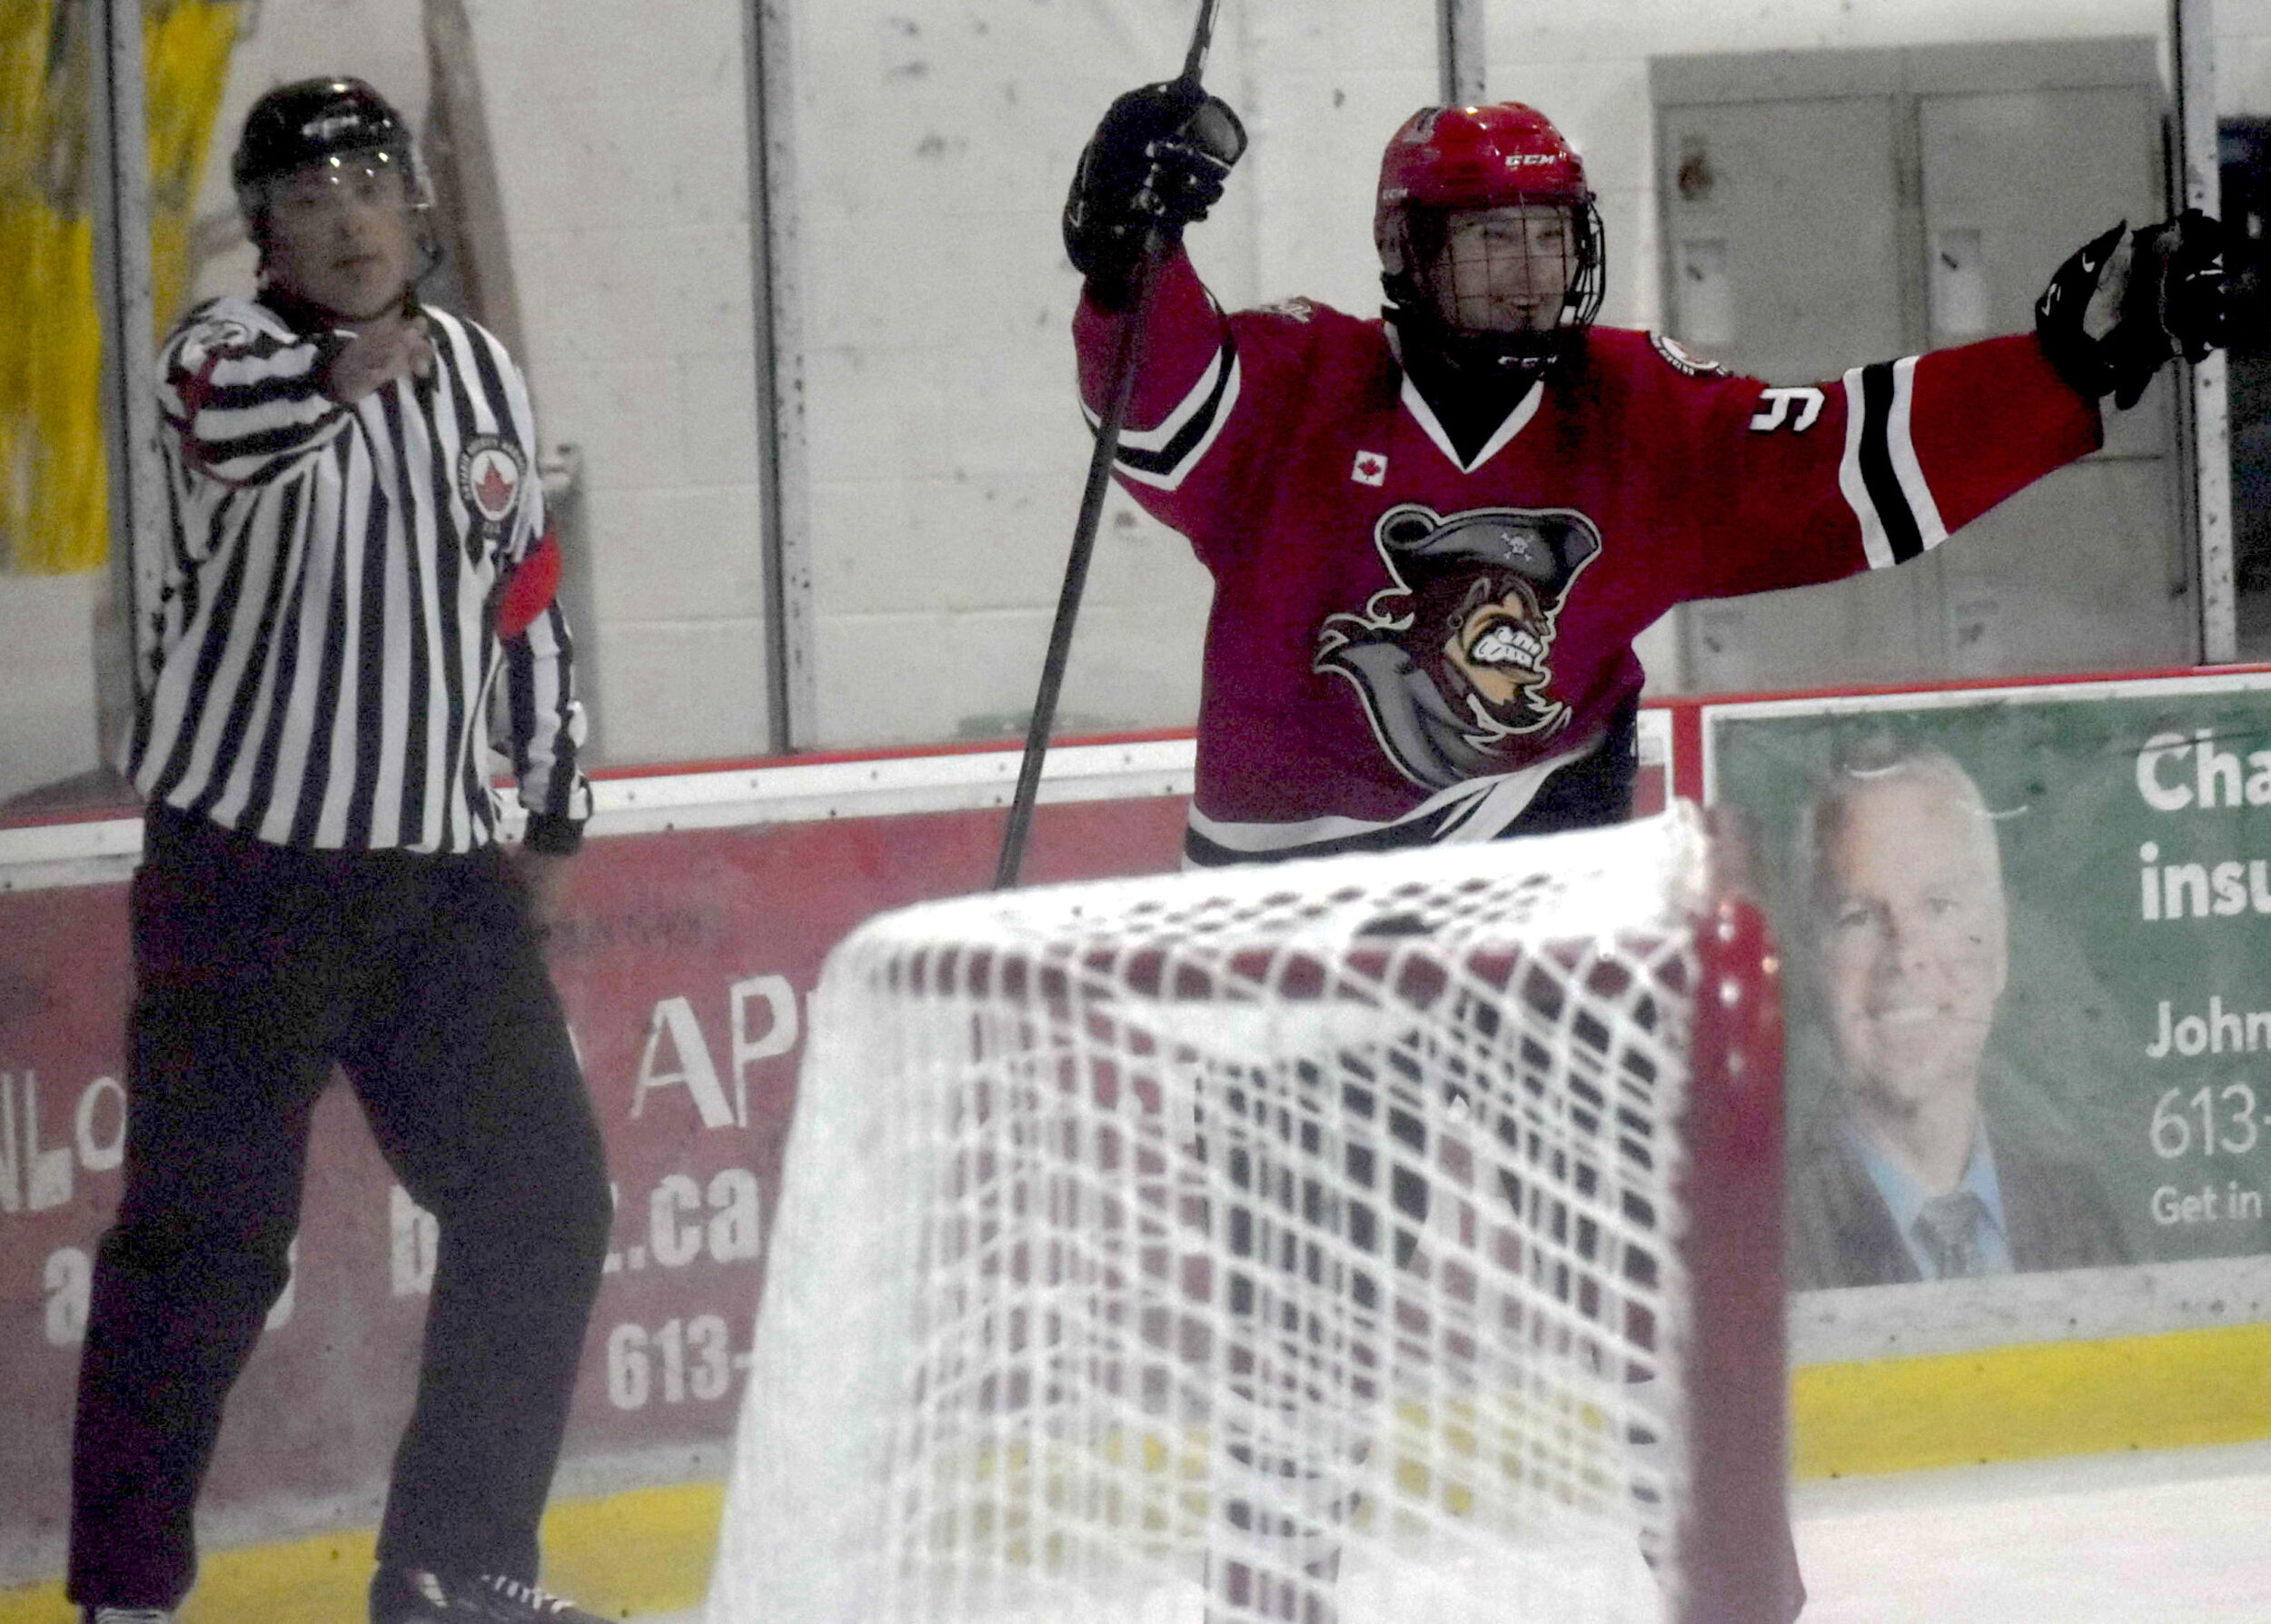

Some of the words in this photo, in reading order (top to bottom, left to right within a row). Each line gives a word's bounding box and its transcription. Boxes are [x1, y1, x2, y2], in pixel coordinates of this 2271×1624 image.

[1505, 153, 1555, 167] CCM
[2137, 728, 2271, 811] Cha
[630, 974, 804, 1130] AP
[2145, 995, 2271, 1057] John
[2152, 1184, 2218, 1224] Get
[2227, 1180, 2263, 1220] in
